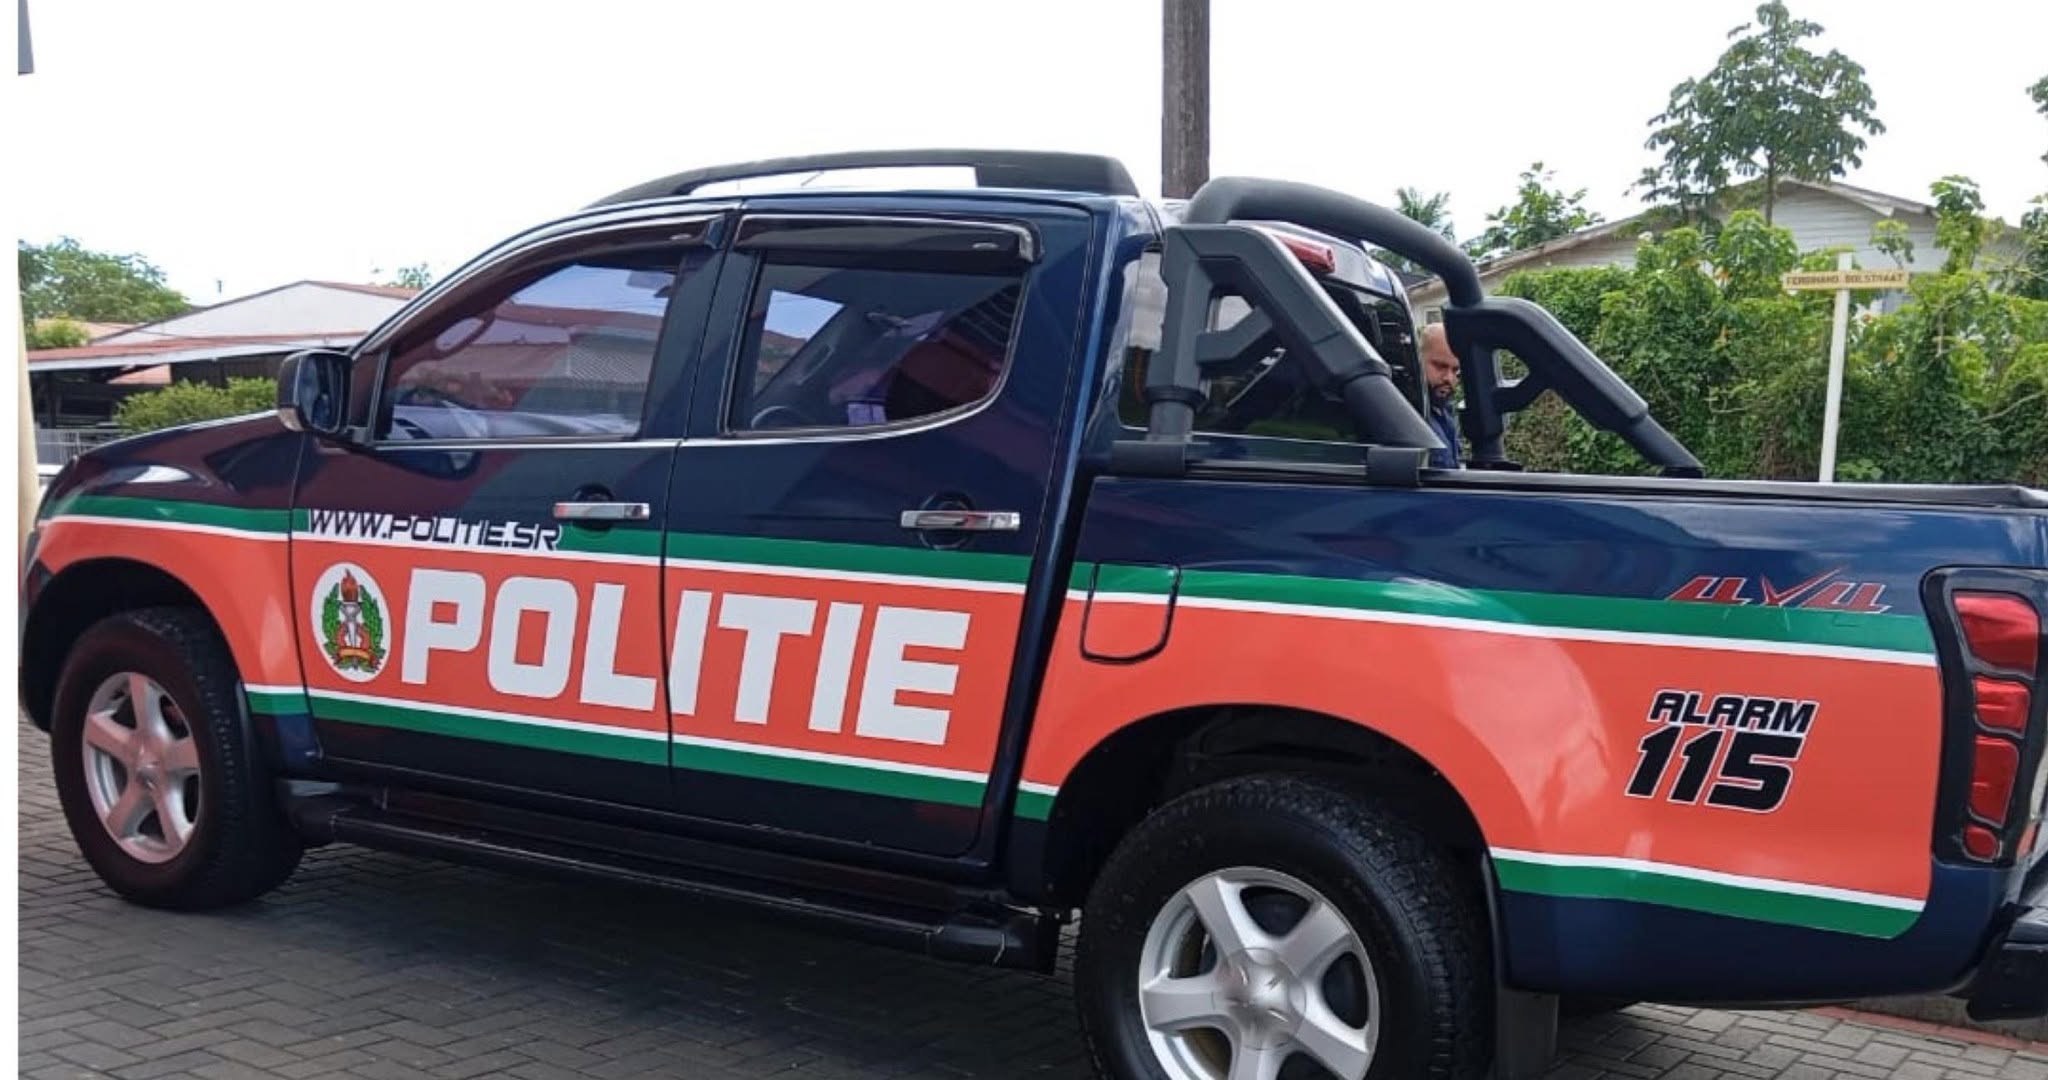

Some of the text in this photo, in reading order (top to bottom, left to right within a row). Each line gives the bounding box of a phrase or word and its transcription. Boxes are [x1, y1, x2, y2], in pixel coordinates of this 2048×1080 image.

[310, 509, 562, 551] WWW.POLITIE.SR
[401, 567, 971, 745] POLITIE
[1647, 690, 1820, 735] ALARM
[1625, 724, 1804, 814] 115
